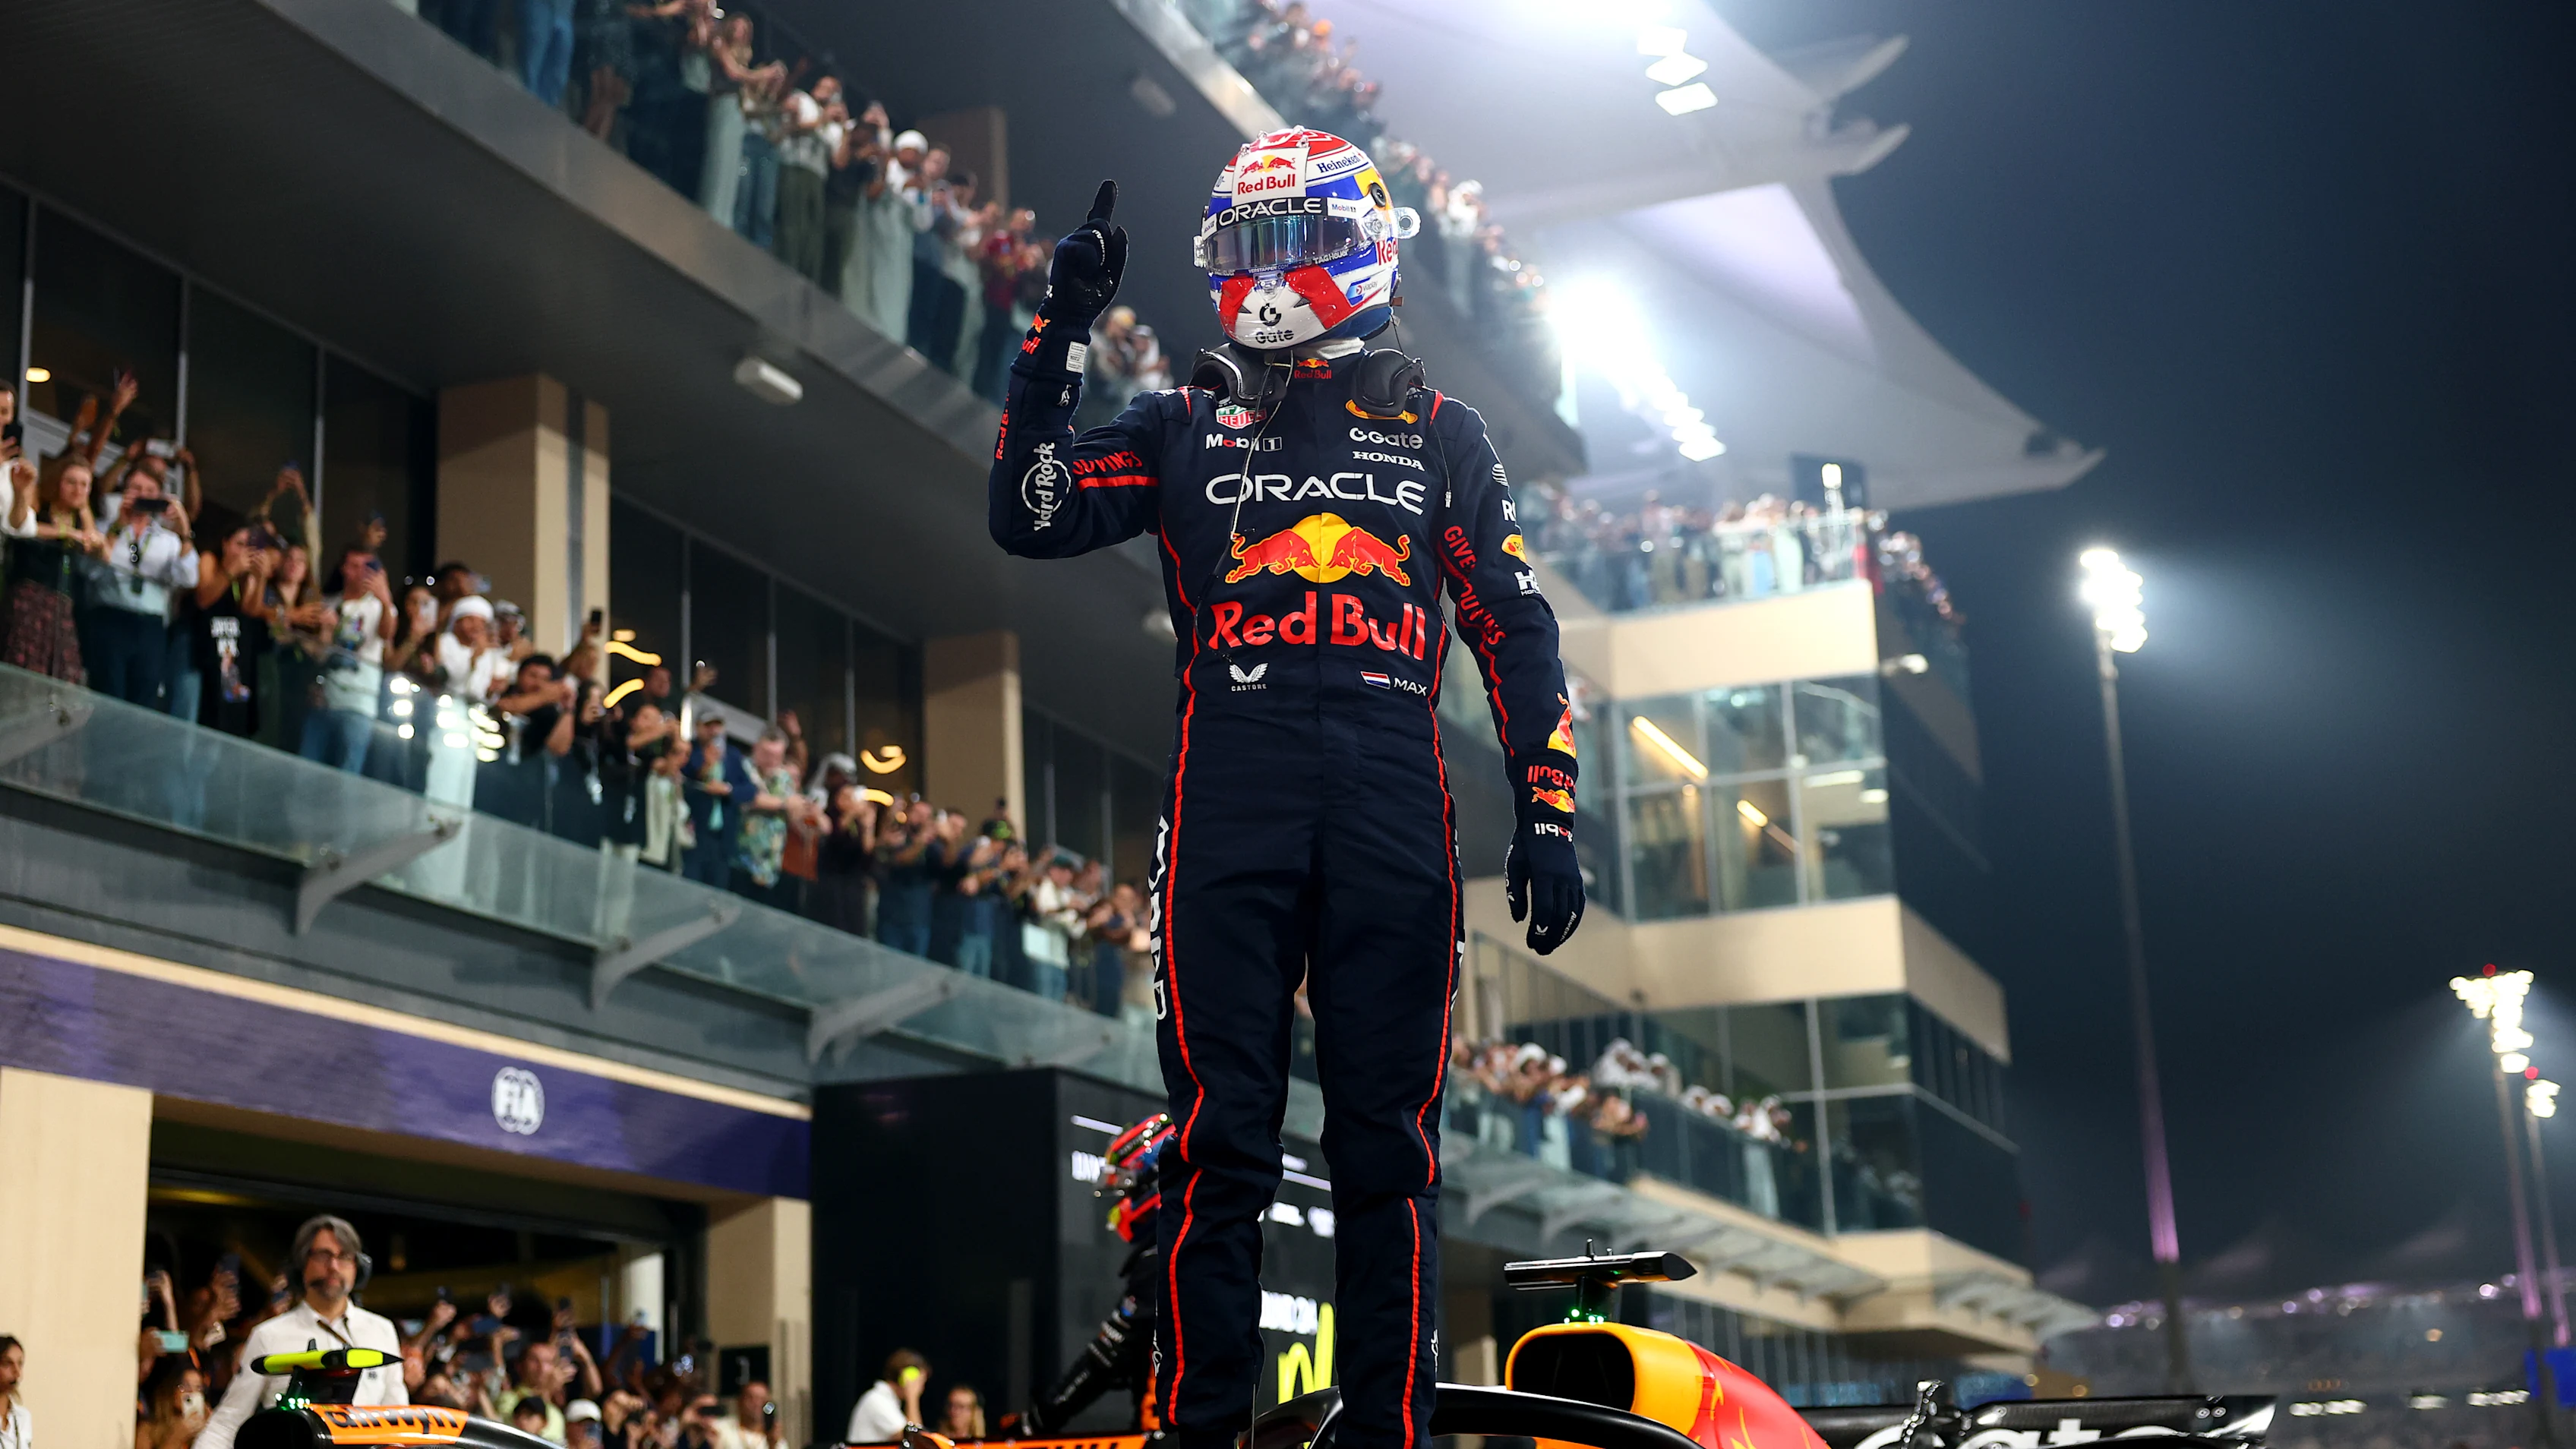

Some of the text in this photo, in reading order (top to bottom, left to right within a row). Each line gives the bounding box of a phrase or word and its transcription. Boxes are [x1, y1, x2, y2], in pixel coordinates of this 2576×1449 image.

[1316, 153, 1360, 173] Heineken
[1237, 177, 1263, 194] Red
[1266, 174, 1296, 189] Bull
[1219, 197, 1323, 226] ORACLE
[1331, 204, 1350, 212] Mobil
[1255, 329, 1294, 344] Gate
[1294, 369, 1332, 379] Red Bull
[1205, 433, 1260, 451] Mobil
[1368, 431, 1423, 450] Gate
[1352, 450, 1425, 472] HONDA
[1033, 442, 1057, 532] Hard Rock
[1205, 472, 1427, 516] ORACLE
[1444, 525, 1476, 570] GIVE
[1208, 591, 1426, 661] Red Bull
[1231, 683, 1267, 692] CASTORE
[1394, 677, 1428, 696] MAX
[1526, 765, 1564, 788] Bull
